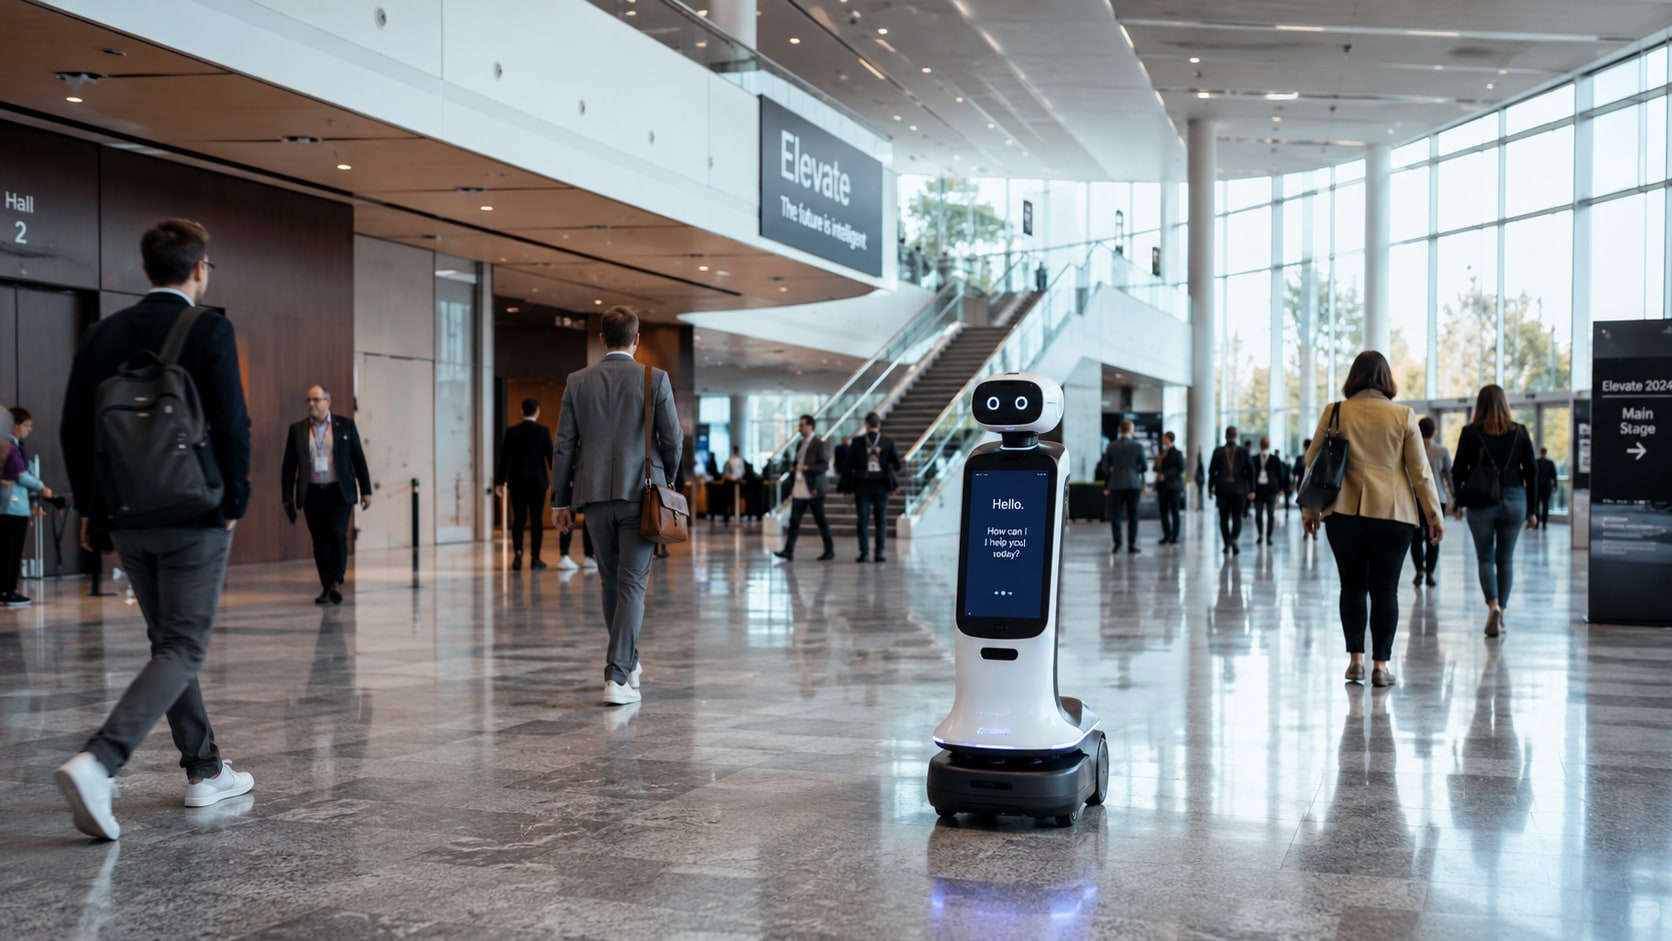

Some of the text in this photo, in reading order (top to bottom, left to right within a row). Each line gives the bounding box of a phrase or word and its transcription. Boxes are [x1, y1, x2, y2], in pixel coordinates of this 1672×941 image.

[781, 129, 851, 206] Elevate
[5, 191, 34, 213] Hall
[780, 195, 867, 250] The future is intelligent
[15, 221, 27, 244] 2
[1602, 380, 1643, 392] Elevate
[1622, 407, 1654, 420] Main
[1620, 422, 1656, 437] Stage
[992, 498, 1024, 510] Hello.
[987, 527, 1006, 536] How
[1007, 528, 1023, 536] can
[989, 537, 1007, 548] help
